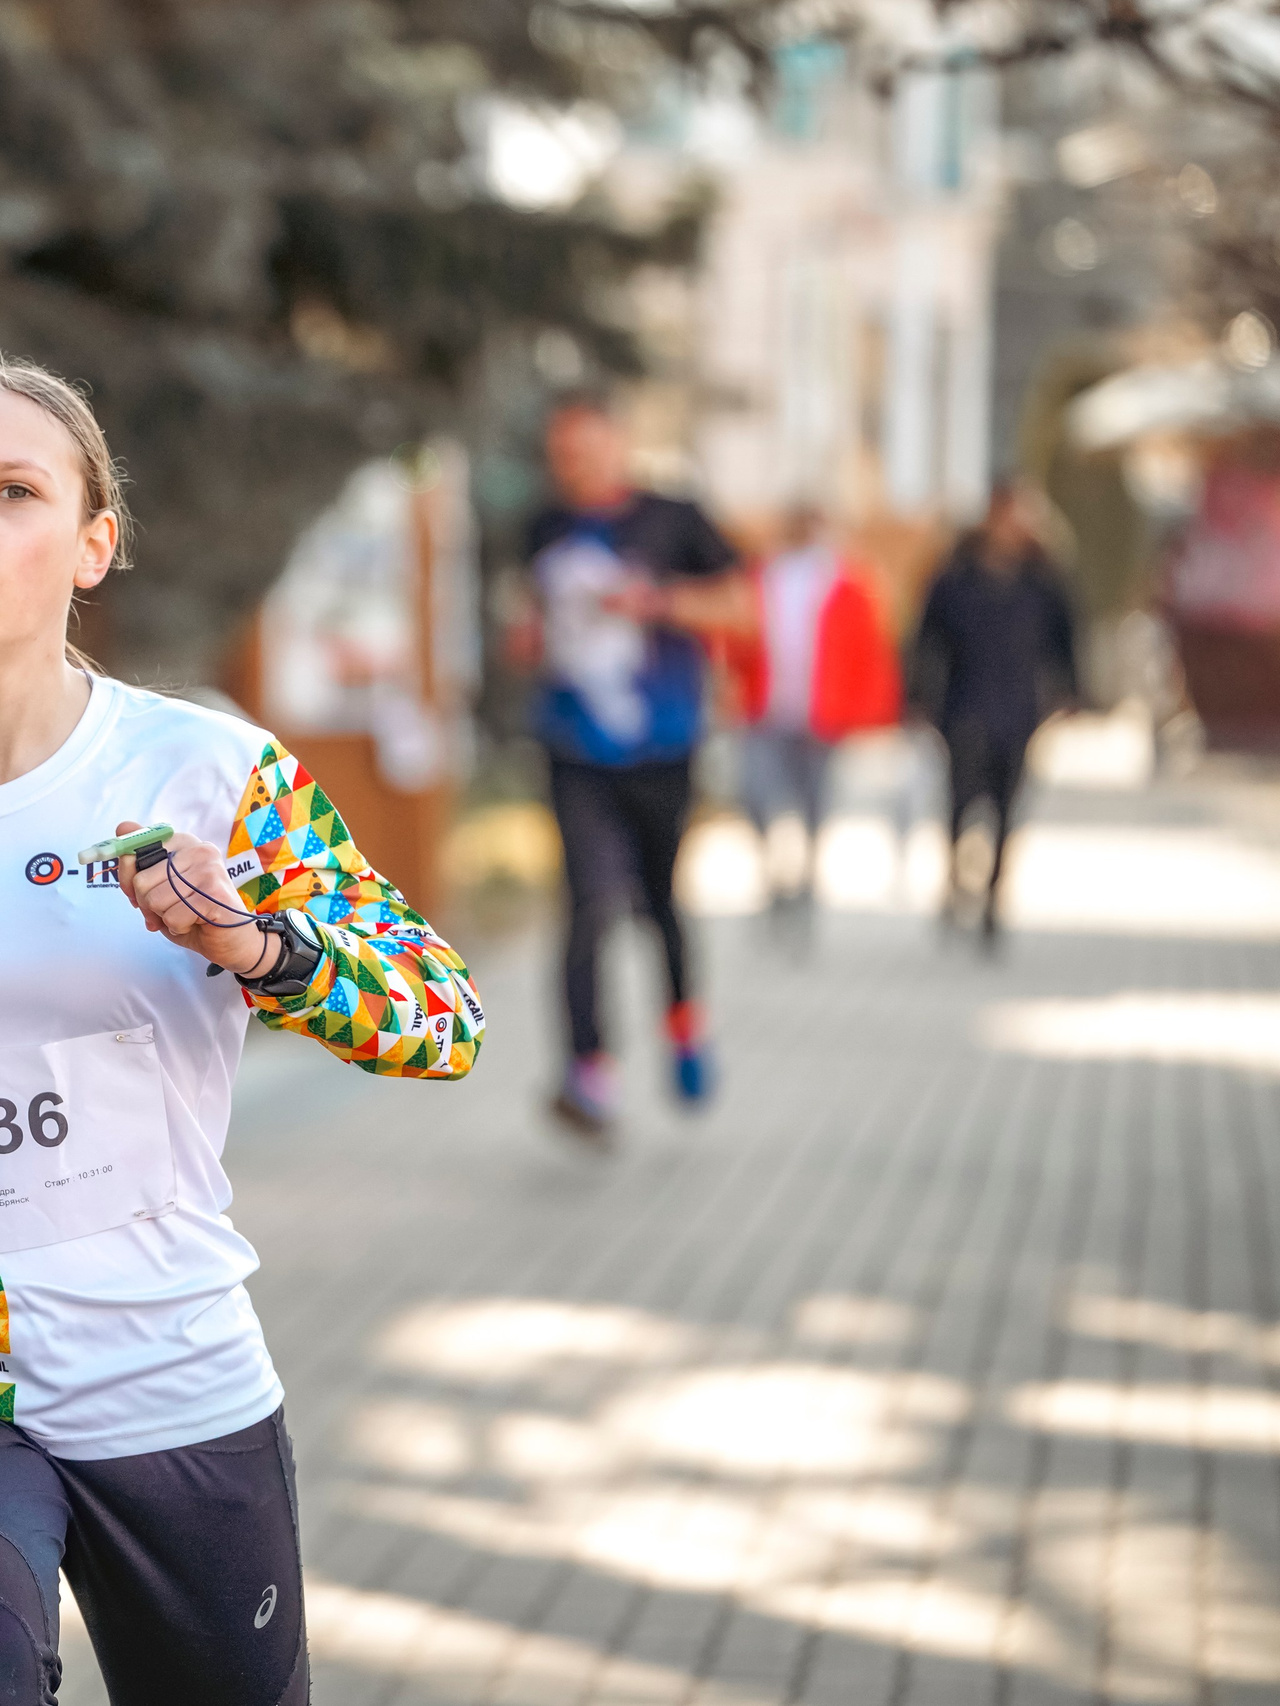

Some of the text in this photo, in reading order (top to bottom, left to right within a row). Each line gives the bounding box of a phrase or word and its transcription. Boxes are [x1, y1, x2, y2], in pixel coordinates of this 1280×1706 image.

[227, 860, 255, 879] RAIL
[44, 1177, 70, 1188] Старт
[78, 1164, 113, 1180] 10:31:00
